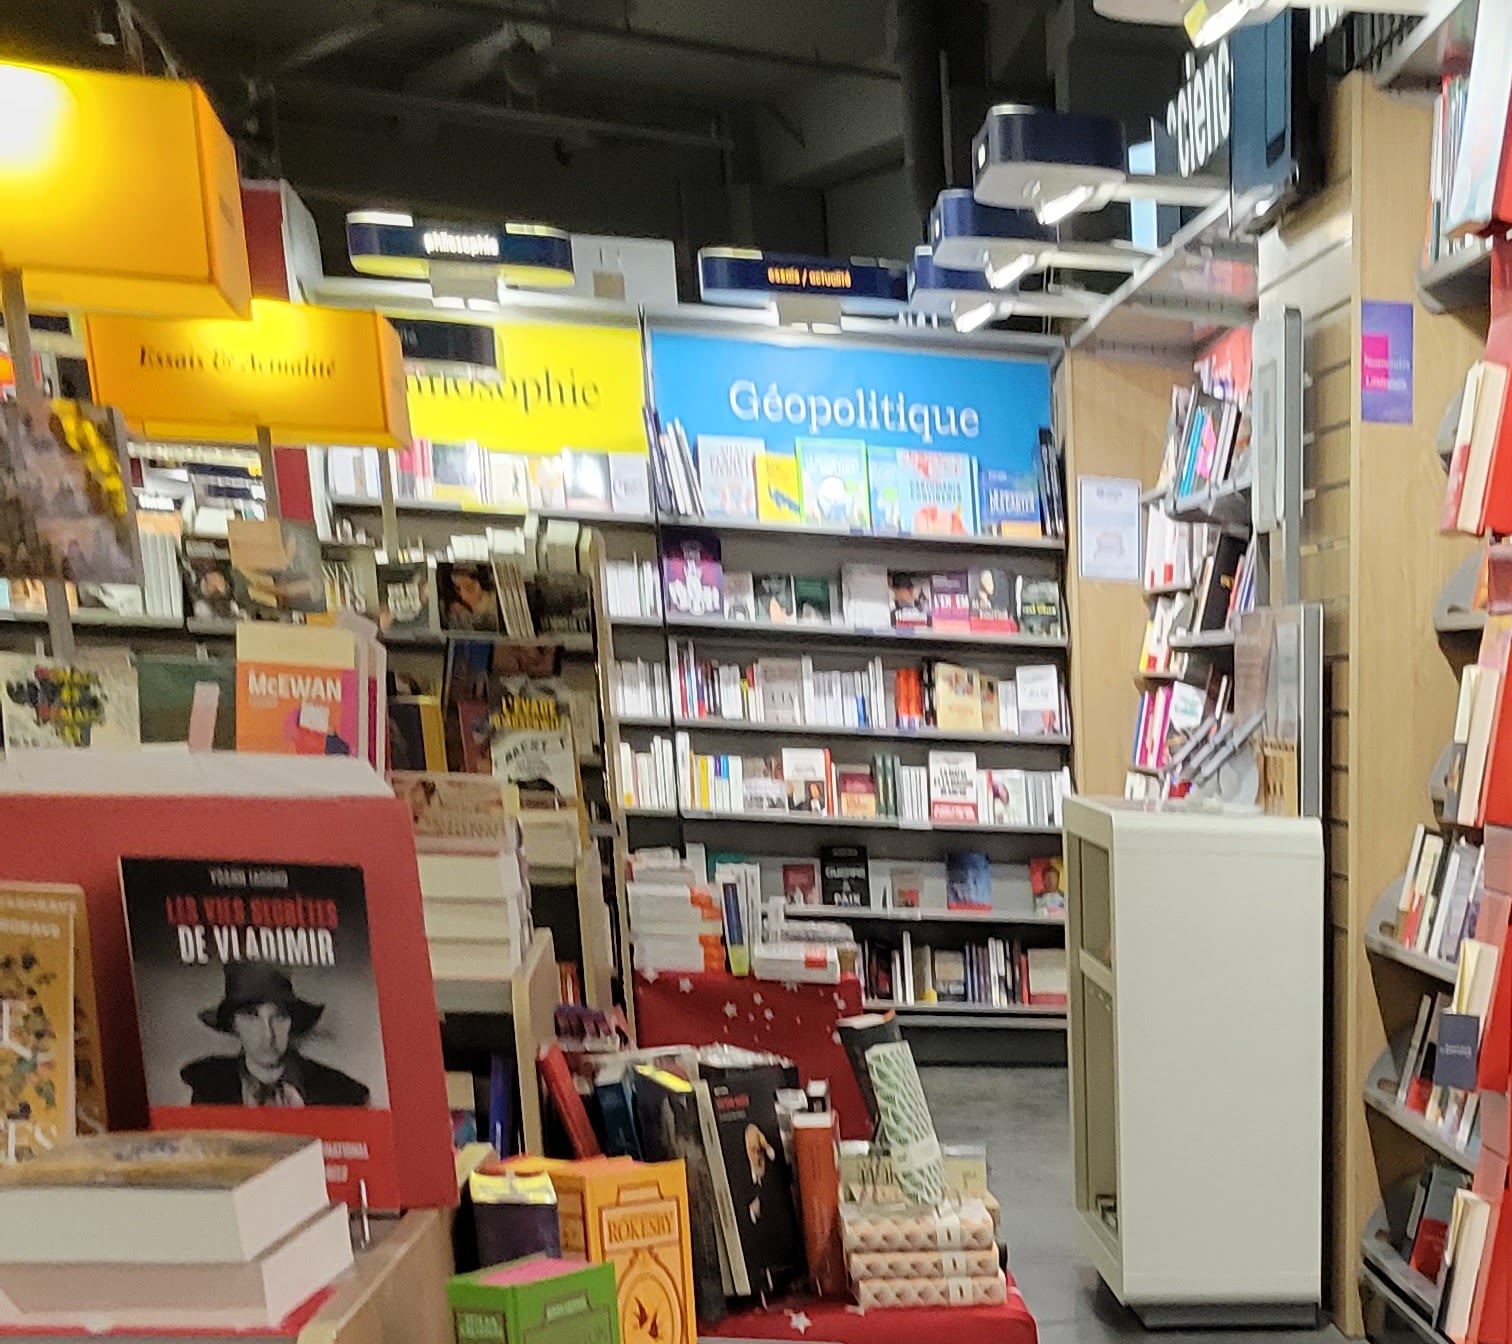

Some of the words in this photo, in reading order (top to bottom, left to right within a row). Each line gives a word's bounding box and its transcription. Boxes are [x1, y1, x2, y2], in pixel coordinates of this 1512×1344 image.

[729, 379, 980, 444] Géopolitique
[247, 670, 342, 702] McEWAN
[177, 924, 209, 965] DE
[213, 924, 336, 966] VLADIMIR
[606, 1211, 675, 1243] ROKESBY
